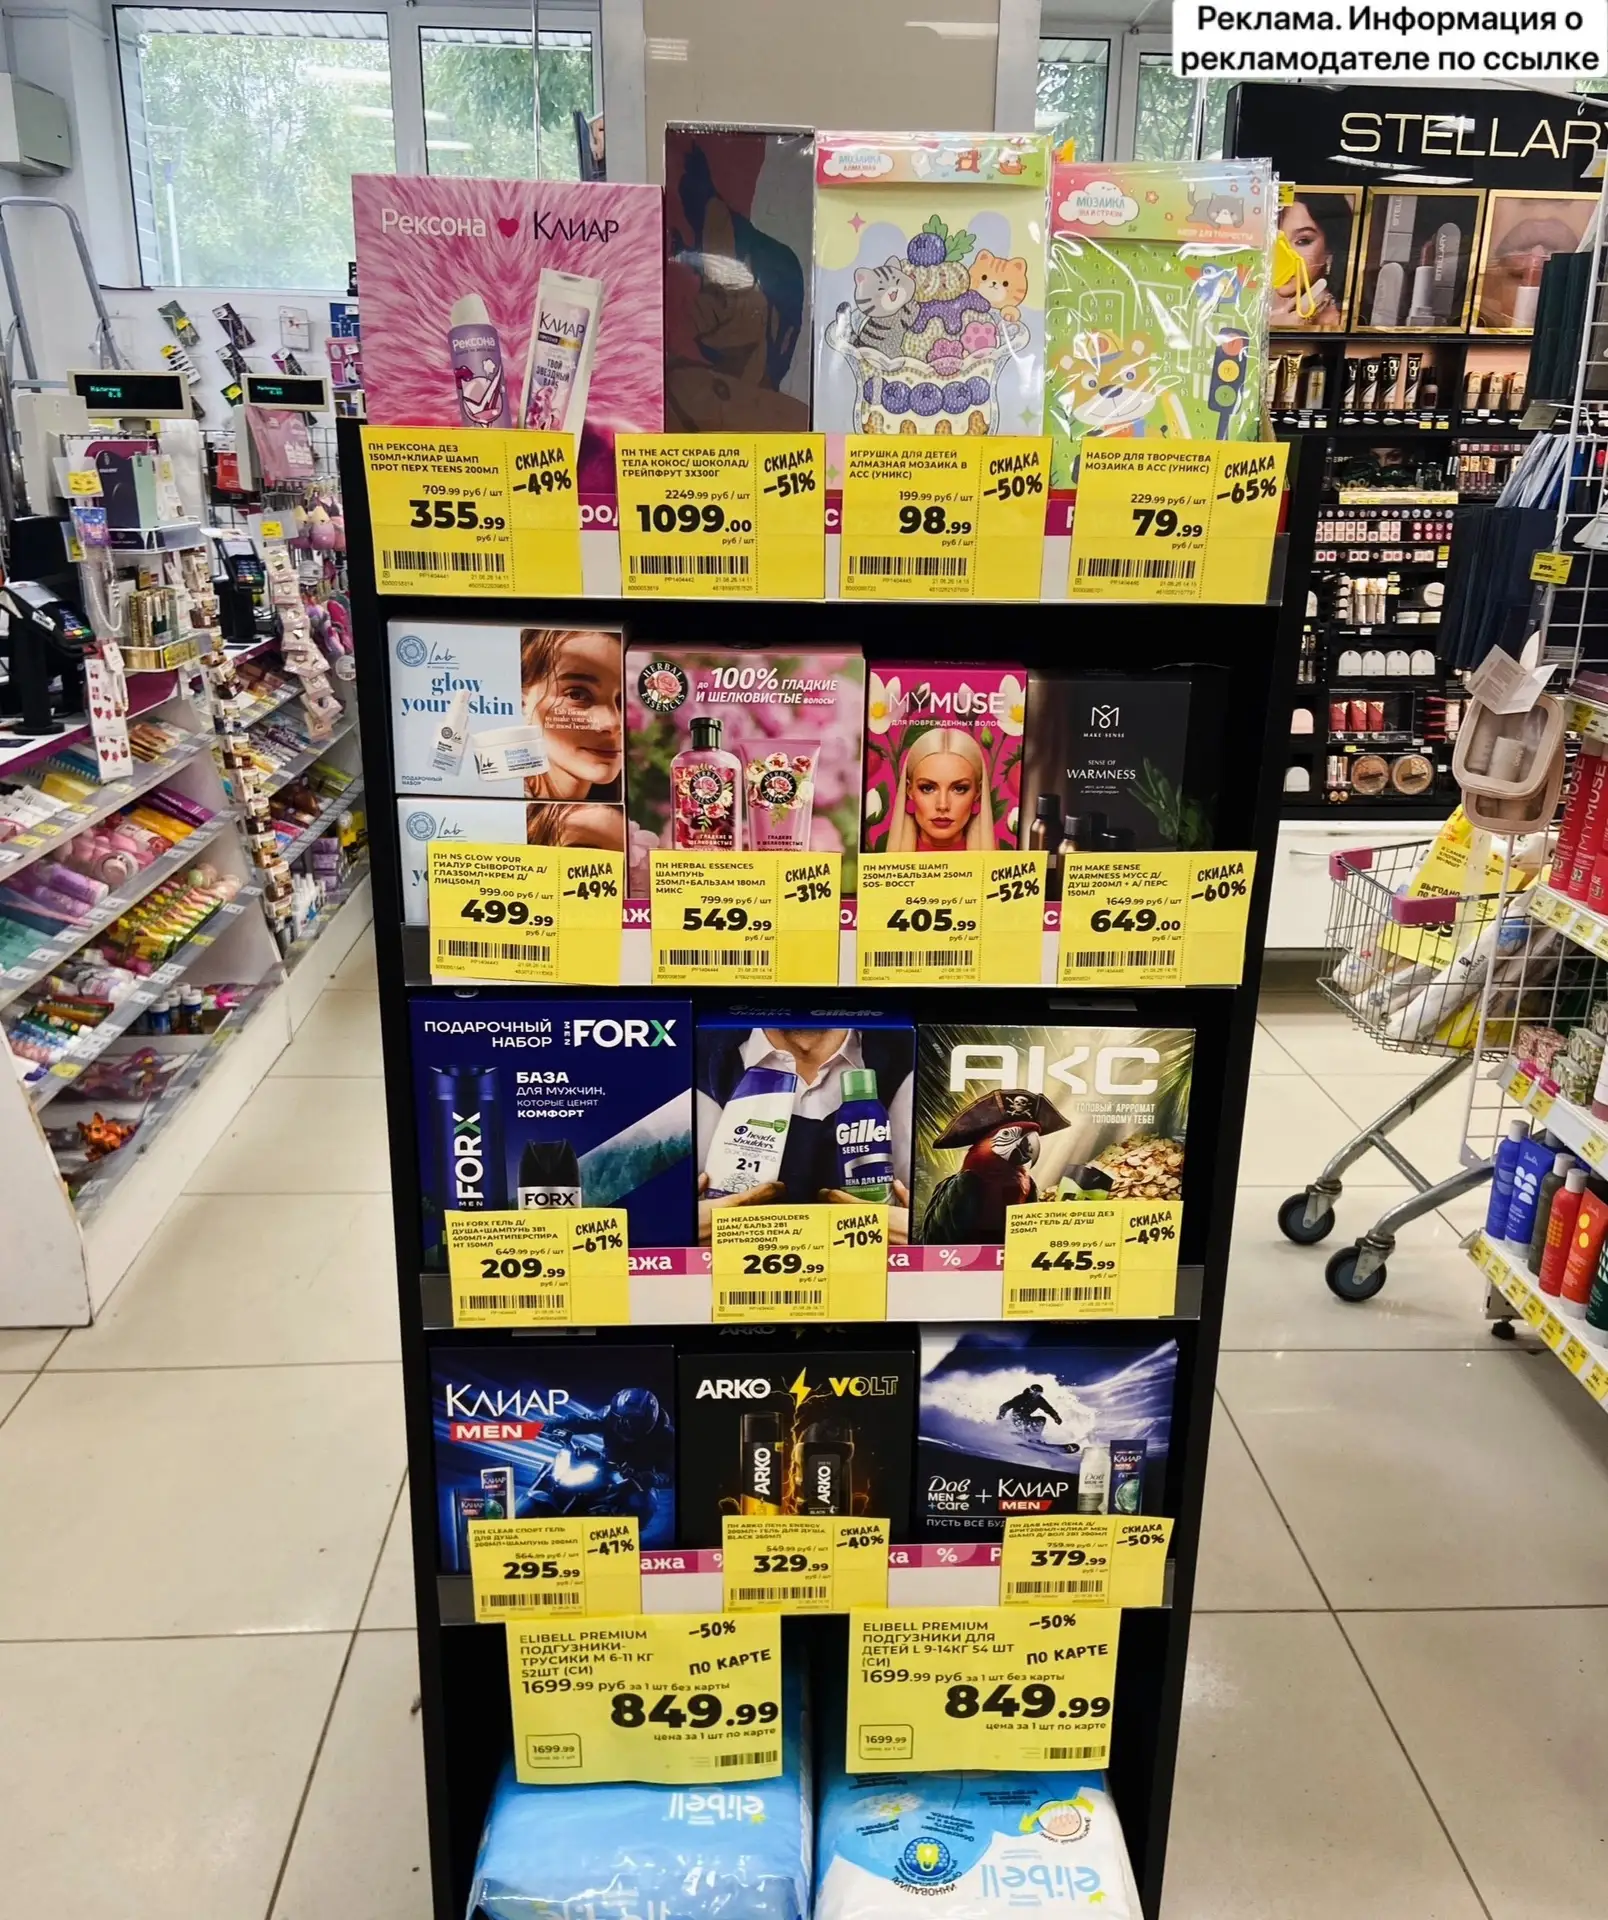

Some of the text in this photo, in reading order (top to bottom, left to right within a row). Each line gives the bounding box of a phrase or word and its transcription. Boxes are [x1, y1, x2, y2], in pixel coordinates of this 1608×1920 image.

[1340, 112, 1608, 159] STELLAR
[381, 208, 486, 237] Рексона
[1435, 233, 1447, 281] STELLARY
[369, 443, 458, 453] ПН РЕКСОНА ДЕЗ
[719, 449, 740, 458] ДЛЯ
[850, 450, 957, 459] ИГРУШКА ДЛЯ ДЕТЕЙ
[1087, 452, 1211, 462] НАБОР ДЛЯ ТВОРЧЕСТВА
[370, 454, 443, 462] 150МЛ+КЛИАР
[516, 448, 564, 470] СКИДКА
[651, 459, 690, 467] КОКОС/
[693, 460, 749, 468] ШОКОЛАД/
[431, 465, 462, 473] TEENS
[465, 466, 498, 474] 200МЛ
[622, 469, 681, 477] ГРЕЙПФРУТ
[423, 485, 460, 495] 709.99
[513, 469, 571, 495] -49%
[763, 470, 815, 497] -51%
[984, 473, 1042, 500] -50%
[1217, 476, 1277, 504] -65%
[665, 490, 708, 499] 2249.99
[900, 491, 931, 500] 199.99
[1131, 494, 1165, 504] 229.99
[410, 500, 505, 529] 355.99
[636, 504, 751, 533] 1099.00
[899, 506, 971, 534] 98.99
[1132, 509, 1202, 537] 79.99
[427, 641, 459, 664] Lab
[643, 662, 682, 679] HERBAL
[697, 668, 837, 691] до 100% ГЛАДКИЕ
[431, 673, 483, 696] glow
[401, 696, 513, 716] your skin
[641, 691, 685, 711] ESSENCES
[696, 692, 802, 704] И ШЕЛКОВИСТЫЕ
[889, 691, 1006, 714] MYMUSE
[892, 719, 973, 727] ДЛЯ ПОВРЕЖДЕННЫХ
[1067, 769, 1136, 780] WARMNESS
[1579, 763, 1607, 850] MYMUSE
[563, 880, 617, 900] -49%
[785, 881, 831, 902] -31%
[986, 878, 1039, 902] -52%
[1191, 879, 1246, 902] -60%
[461, 899, 553, 926] 499.99
[682, 908, 772, 931] 549.99
[887, 909, 976, 932] 405.99
[1091, 909, 1181, 932] 649.00
[424, 1019, 552, 1035] ПОДАРОЧНЫЙ
[573, 1020, 677, 1048] FORX
[492, 1037, 552, 1048] НАБОР
[516, 1072, 569, 1084] БАЗА
[950, 1044, 1160, 1095] АКС
[516, 1087, 606, 1096] ДЛЯ МУЖЧИН,
[567, 1099, 598, 1107] ЦЕНЯТ
[517, 1110, 584, 1118] КОМФОРТ
[1092, 1114, 1132, 1124] ТОПОВОМУ
[733, 1137, 773, 1150] shoulders
[746, 1130, 775, 1143] head&
[452, 1112, 484, 1199] FORX
[842, 1145, 869, 1154] SERIES
[524, 1193, 575, 1207] FORX
[572, 1233, 622, 1253] -67%
[833, 1229, 882, 1248] -70%
[1125, 1225, 1175, 1244] -49%
[481, 1258, 565, 1278] 209.99
[743, 1254, 824, 1274] 269.99
[1031, 1251, 1115, 1271] 445.99
[696, 1376, 898, 1399] ARKO VOLT
[456, 1425, 522, 1439] MEN
[754, 1447, 771, 1495] ARKO
[817, 1465, 831, 1504] ARKO
[929, 1476, 971, 1492] Дав
[928, 1493, 954, 1501] MEN
[1002, 1501, 1040, 1509] MEN
[927, 1518, 961, 1527] ПУСТЬ
[587, 1539, 634, 1555] -47%
[837, 1535, 884, 1549] -40%
[1117, 1534, 1164, 1546] -50%
[754, 1555, 828, 1573] 329.99
[1031, 1551, 1106, 1566] 379.99
[503, 1561, 580, 1579] 295.99
[689, 1620, 736, 1638] -50%
[863, 1622, 988, 1631] ELIBELL PREMIUM
[1030, 1614, 1076, 1629] -50%
[520, 1631, 647, 1644] ELIBELL PREMIUM
[863, 1633, 961, 1643] ПОДГУЗНИКИ
[521, 1642, 626, 1656] ПОДГУЗНИКИ-
[1027, 1644, 1108, 1665] ПО КАРТЕ
[689, 1649, 771, 1675] ПО КАРТЕ
[863, 1670, 931, 1683] 1699.99
[522, 1679, 593, 1694] 1699.99
[945, 1684, 1110, 1718] 849.99
[611, 1693, 778, 1728] 849.99
[669, 1792, 764, 1821] elibell
[980, 1864, 1100, 1899] elibell
